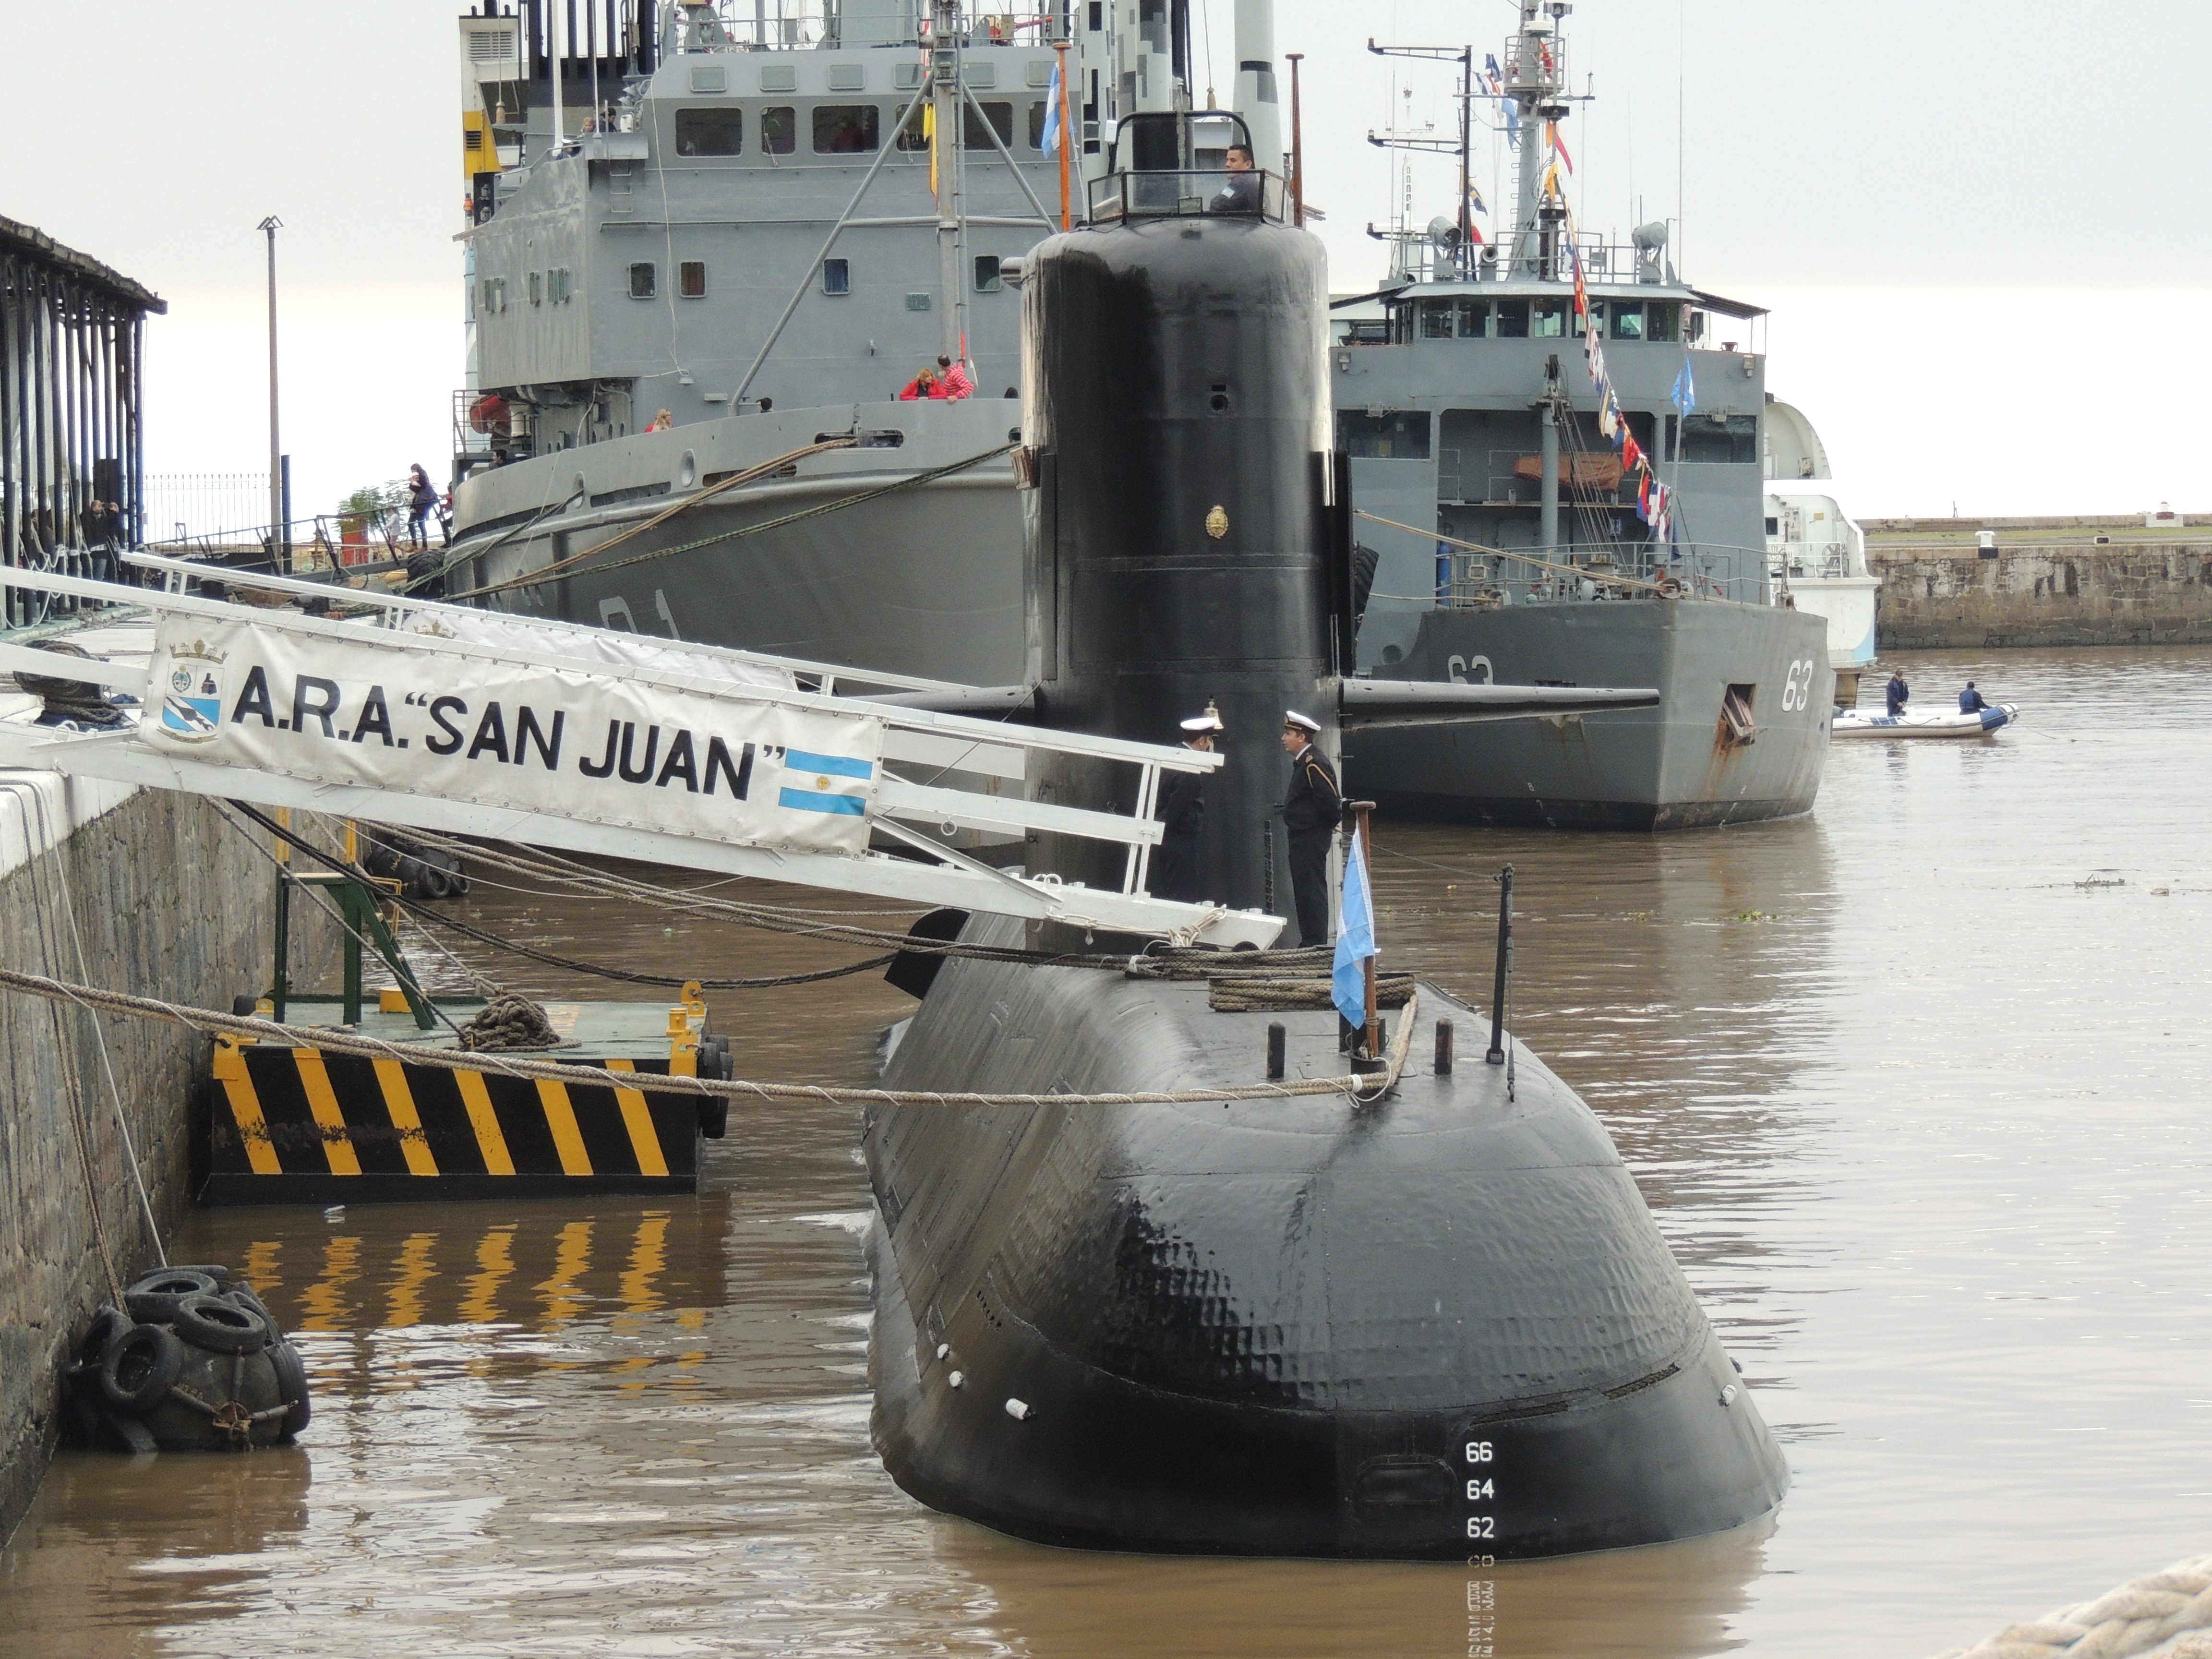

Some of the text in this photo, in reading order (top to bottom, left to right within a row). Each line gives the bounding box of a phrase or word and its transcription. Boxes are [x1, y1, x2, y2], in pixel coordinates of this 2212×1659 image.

[1782, 660, 1813, 711] 63
[231, 665, 409, 748] A.R.A.
[1527, 782, 1535, 792] 8
[1466, 1442, 1493, 1463] 66
[1467, 1478, 1495, 1500] 64
[1467, 1517, 1494, 1539] 62
